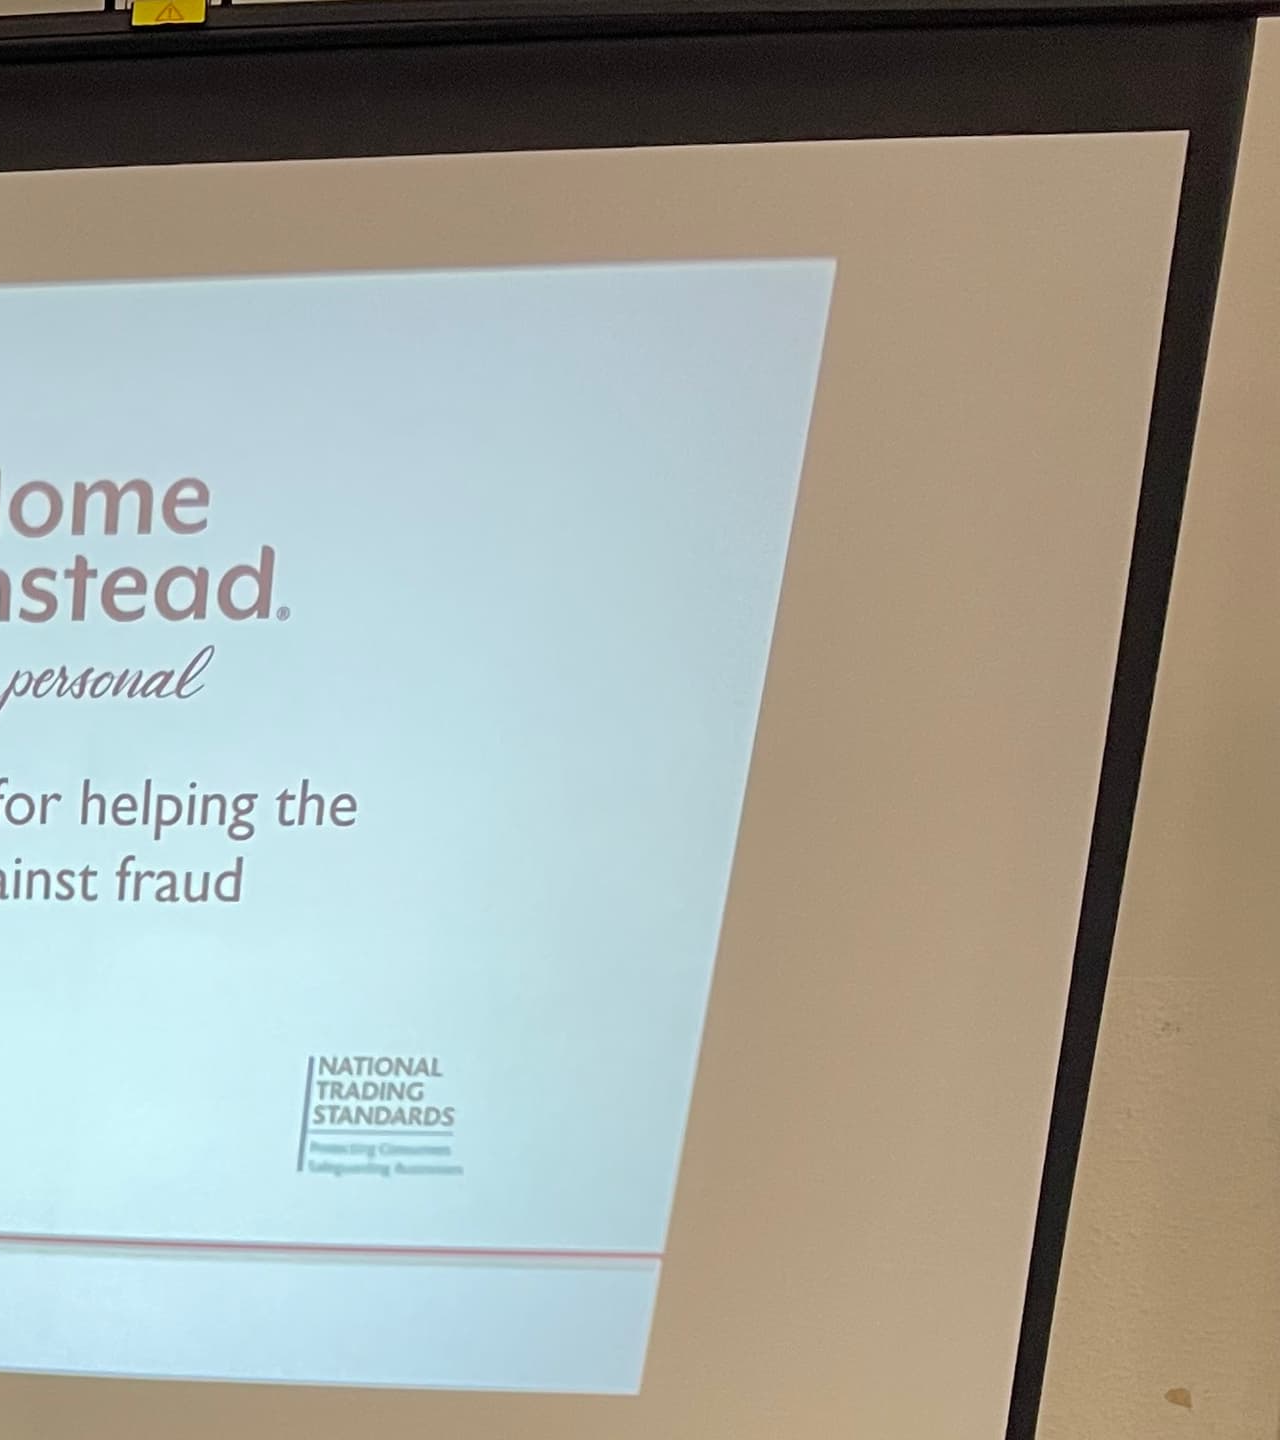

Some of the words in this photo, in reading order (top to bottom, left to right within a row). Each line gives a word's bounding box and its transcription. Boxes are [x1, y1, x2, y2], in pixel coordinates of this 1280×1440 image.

[80, 779, 259, 841] helping
[275, 779, 358, 827] the
[115, 855, 244, 903] fraud
[318, 1056, 443, 1077] NATIONAL
[316, 1080, 424, 1101] TRADING
[312, 1104, 455, 1126] STANDARDS
